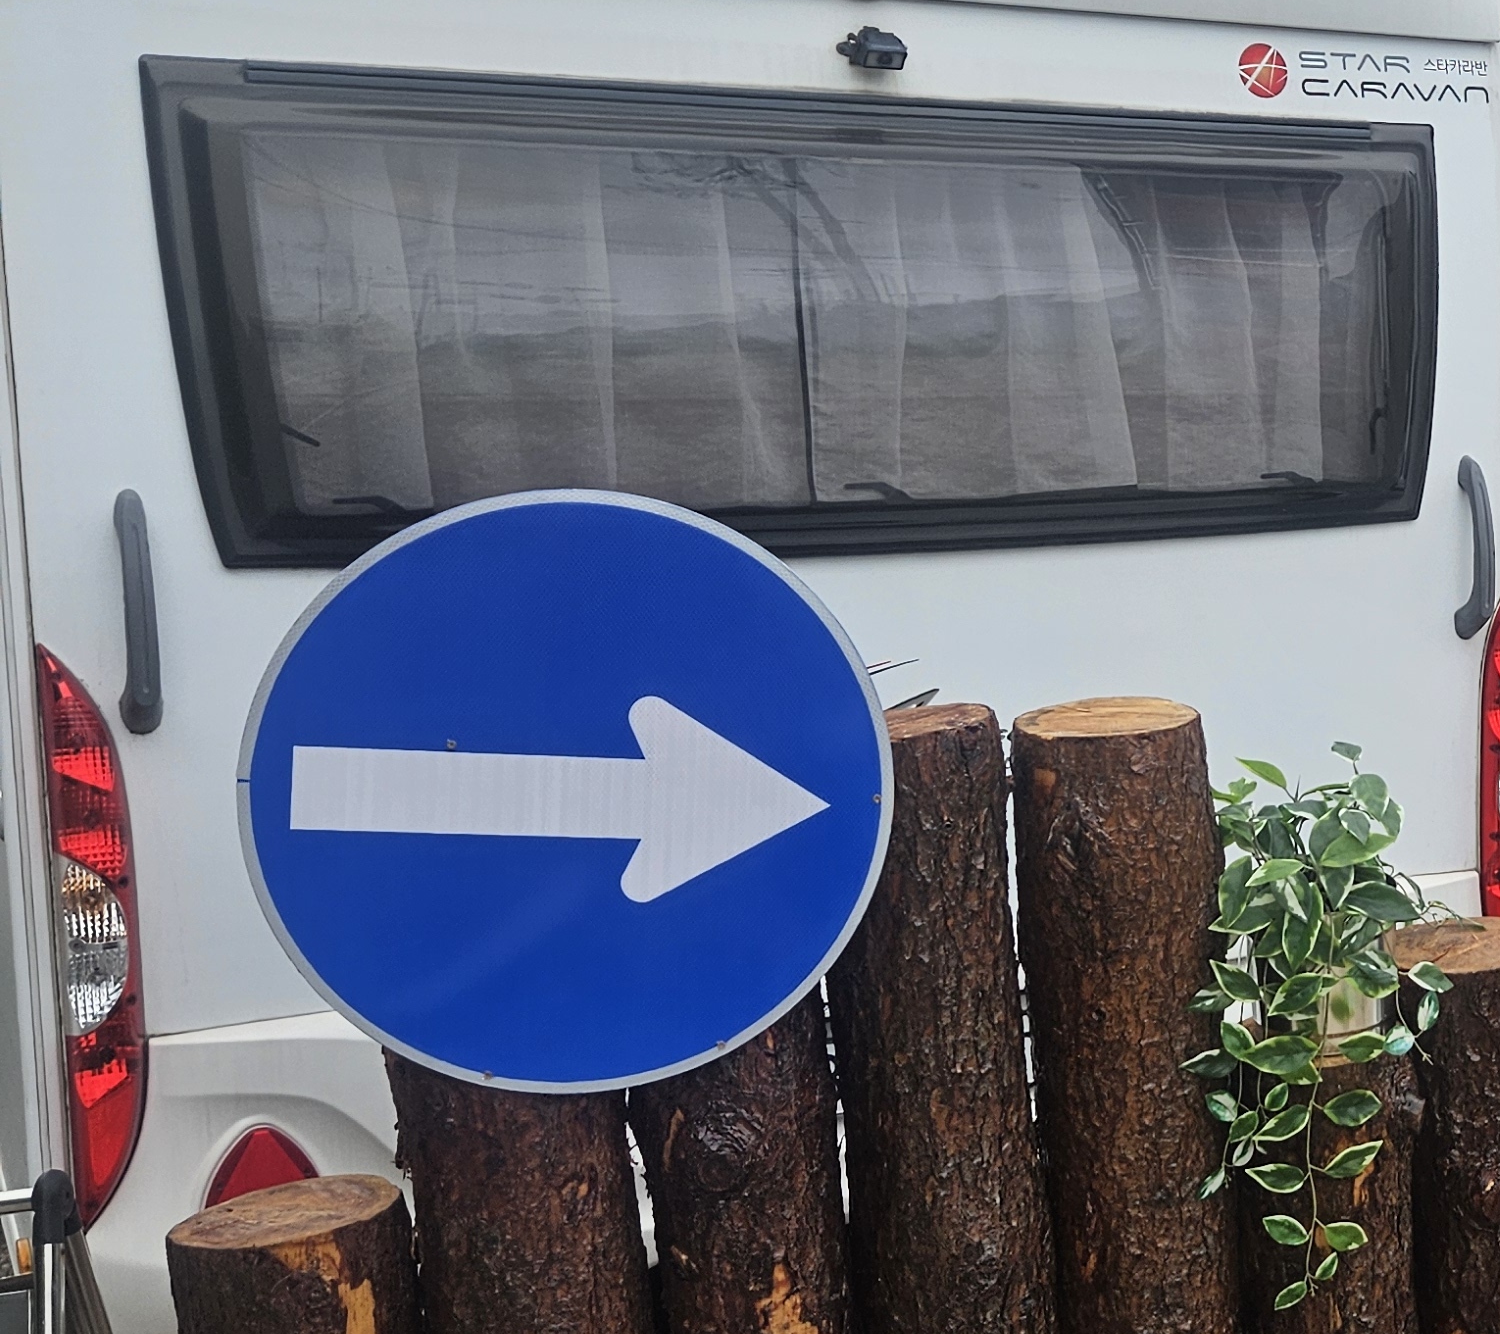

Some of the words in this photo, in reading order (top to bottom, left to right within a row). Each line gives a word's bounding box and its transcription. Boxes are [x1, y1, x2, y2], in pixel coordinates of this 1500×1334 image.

[1299, 51, 1410, 73] STAR
[1423, 58, 1488, 76] 스타카라반
[1301, 78, 1489, 104] CARAVAN
